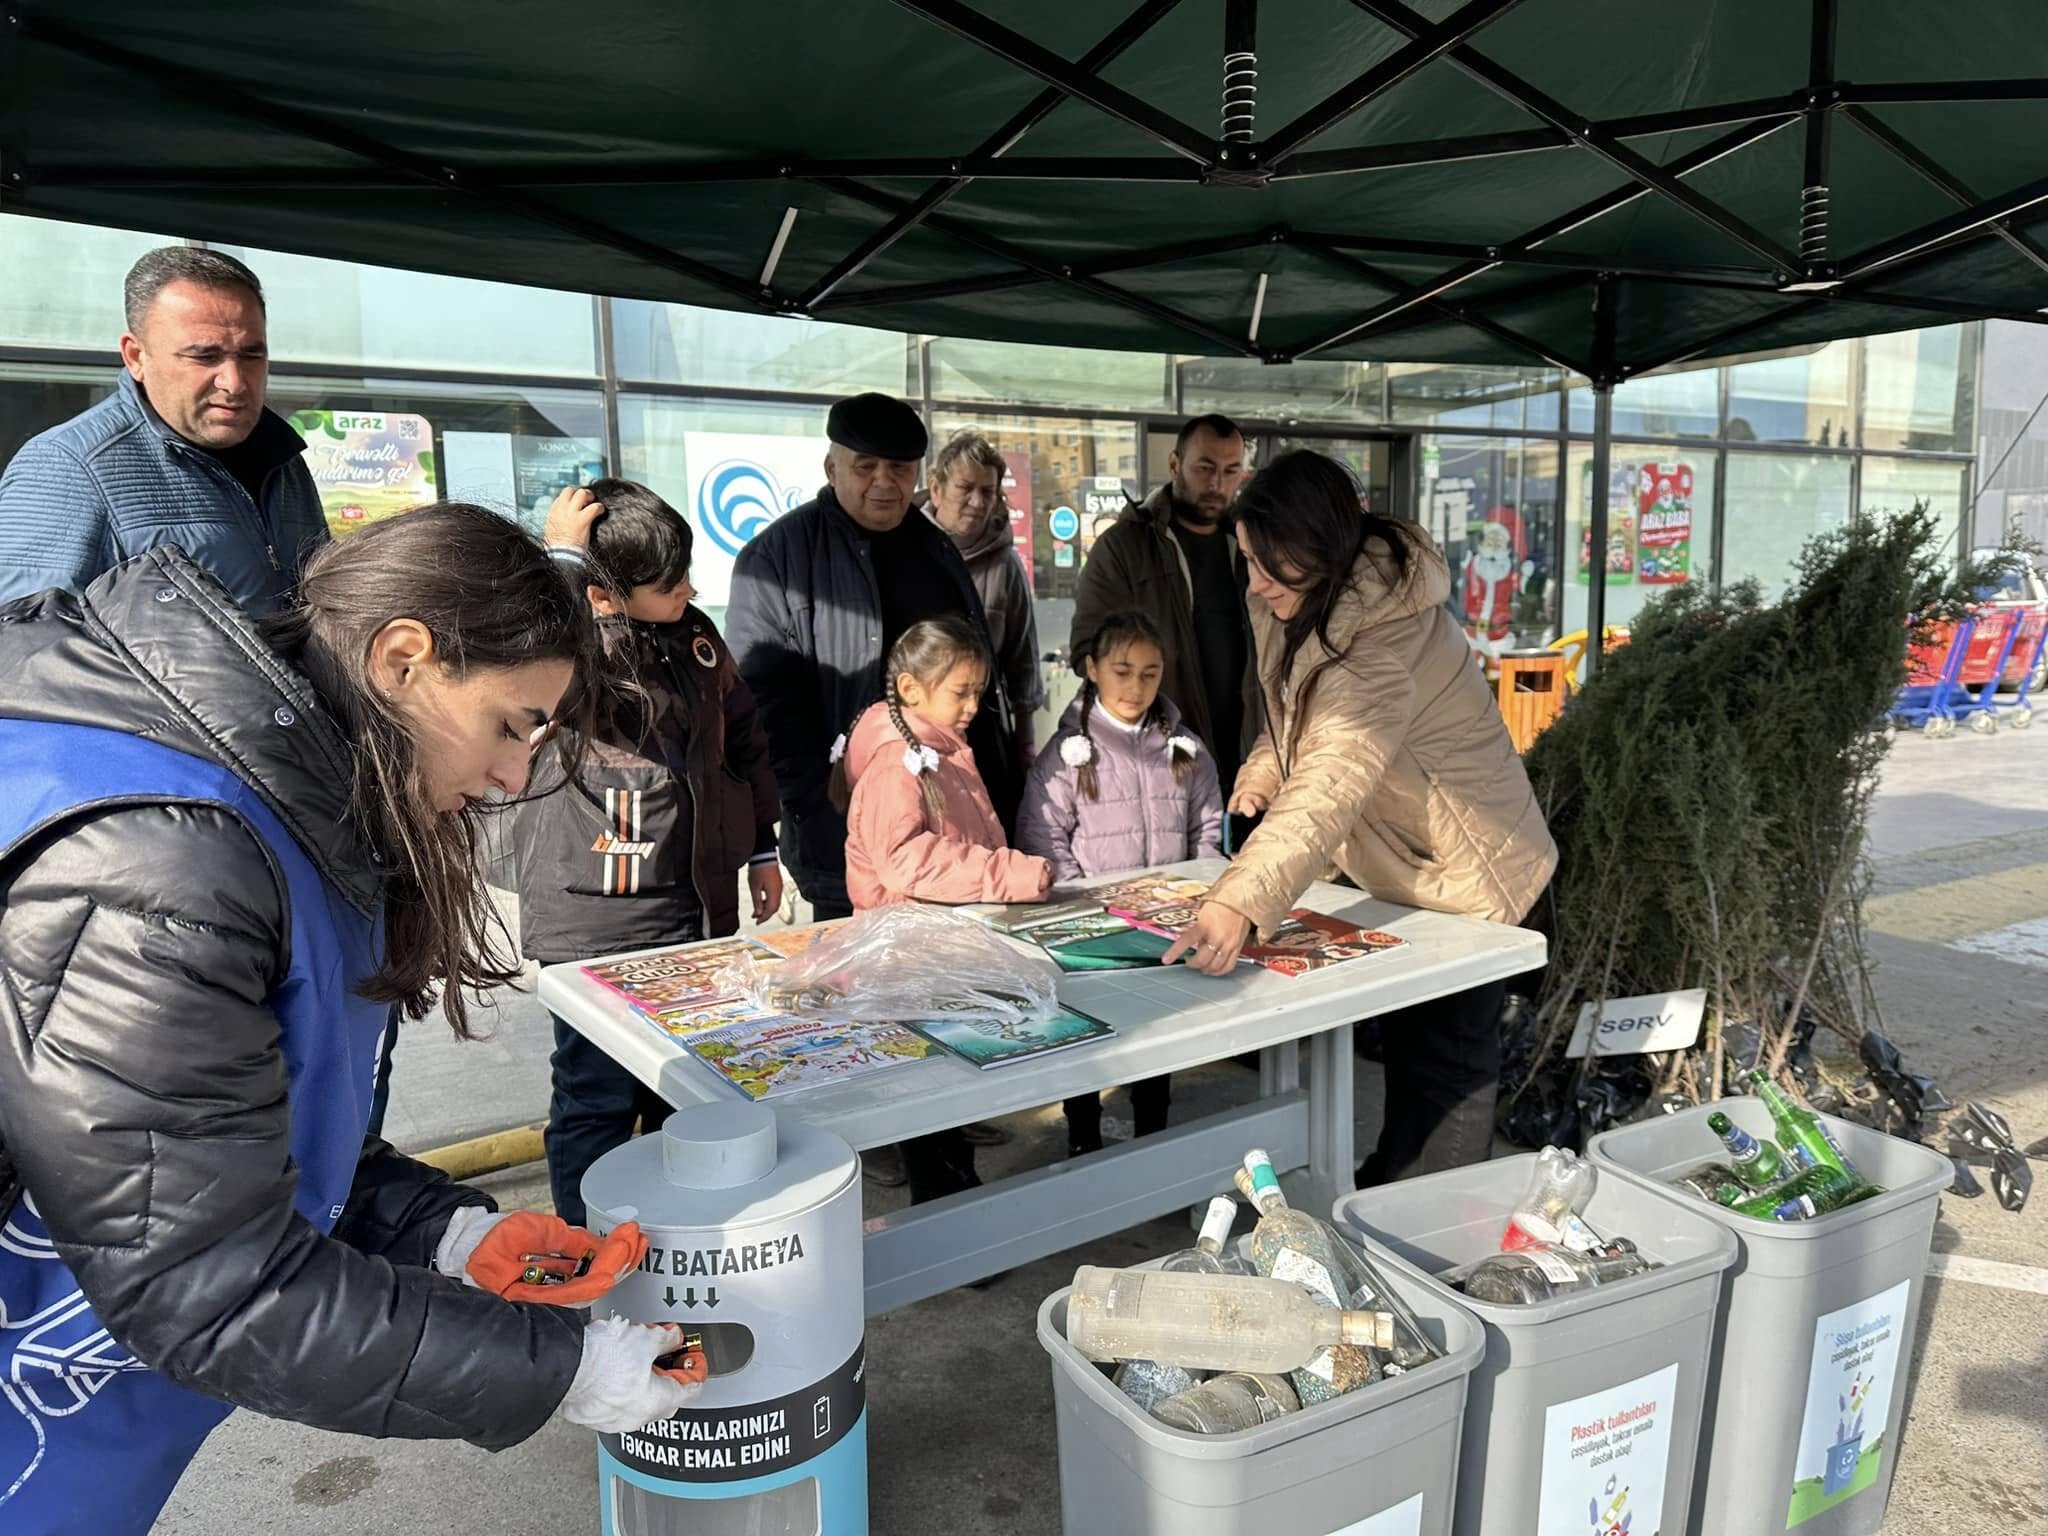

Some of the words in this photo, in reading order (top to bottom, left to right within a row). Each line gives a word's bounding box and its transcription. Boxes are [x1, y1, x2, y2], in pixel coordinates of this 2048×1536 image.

[338, 416, 383, 430] araz
[672, 1233, 804, 1277] BATAREYA
[1570, 1418, 1606, 1442] Plastik
[619, 1431, 680, 1467] TƏKRAR
[684, 1448, 736, 1469] EMAL
[741, 1434, 791, 1465] EDİN!
